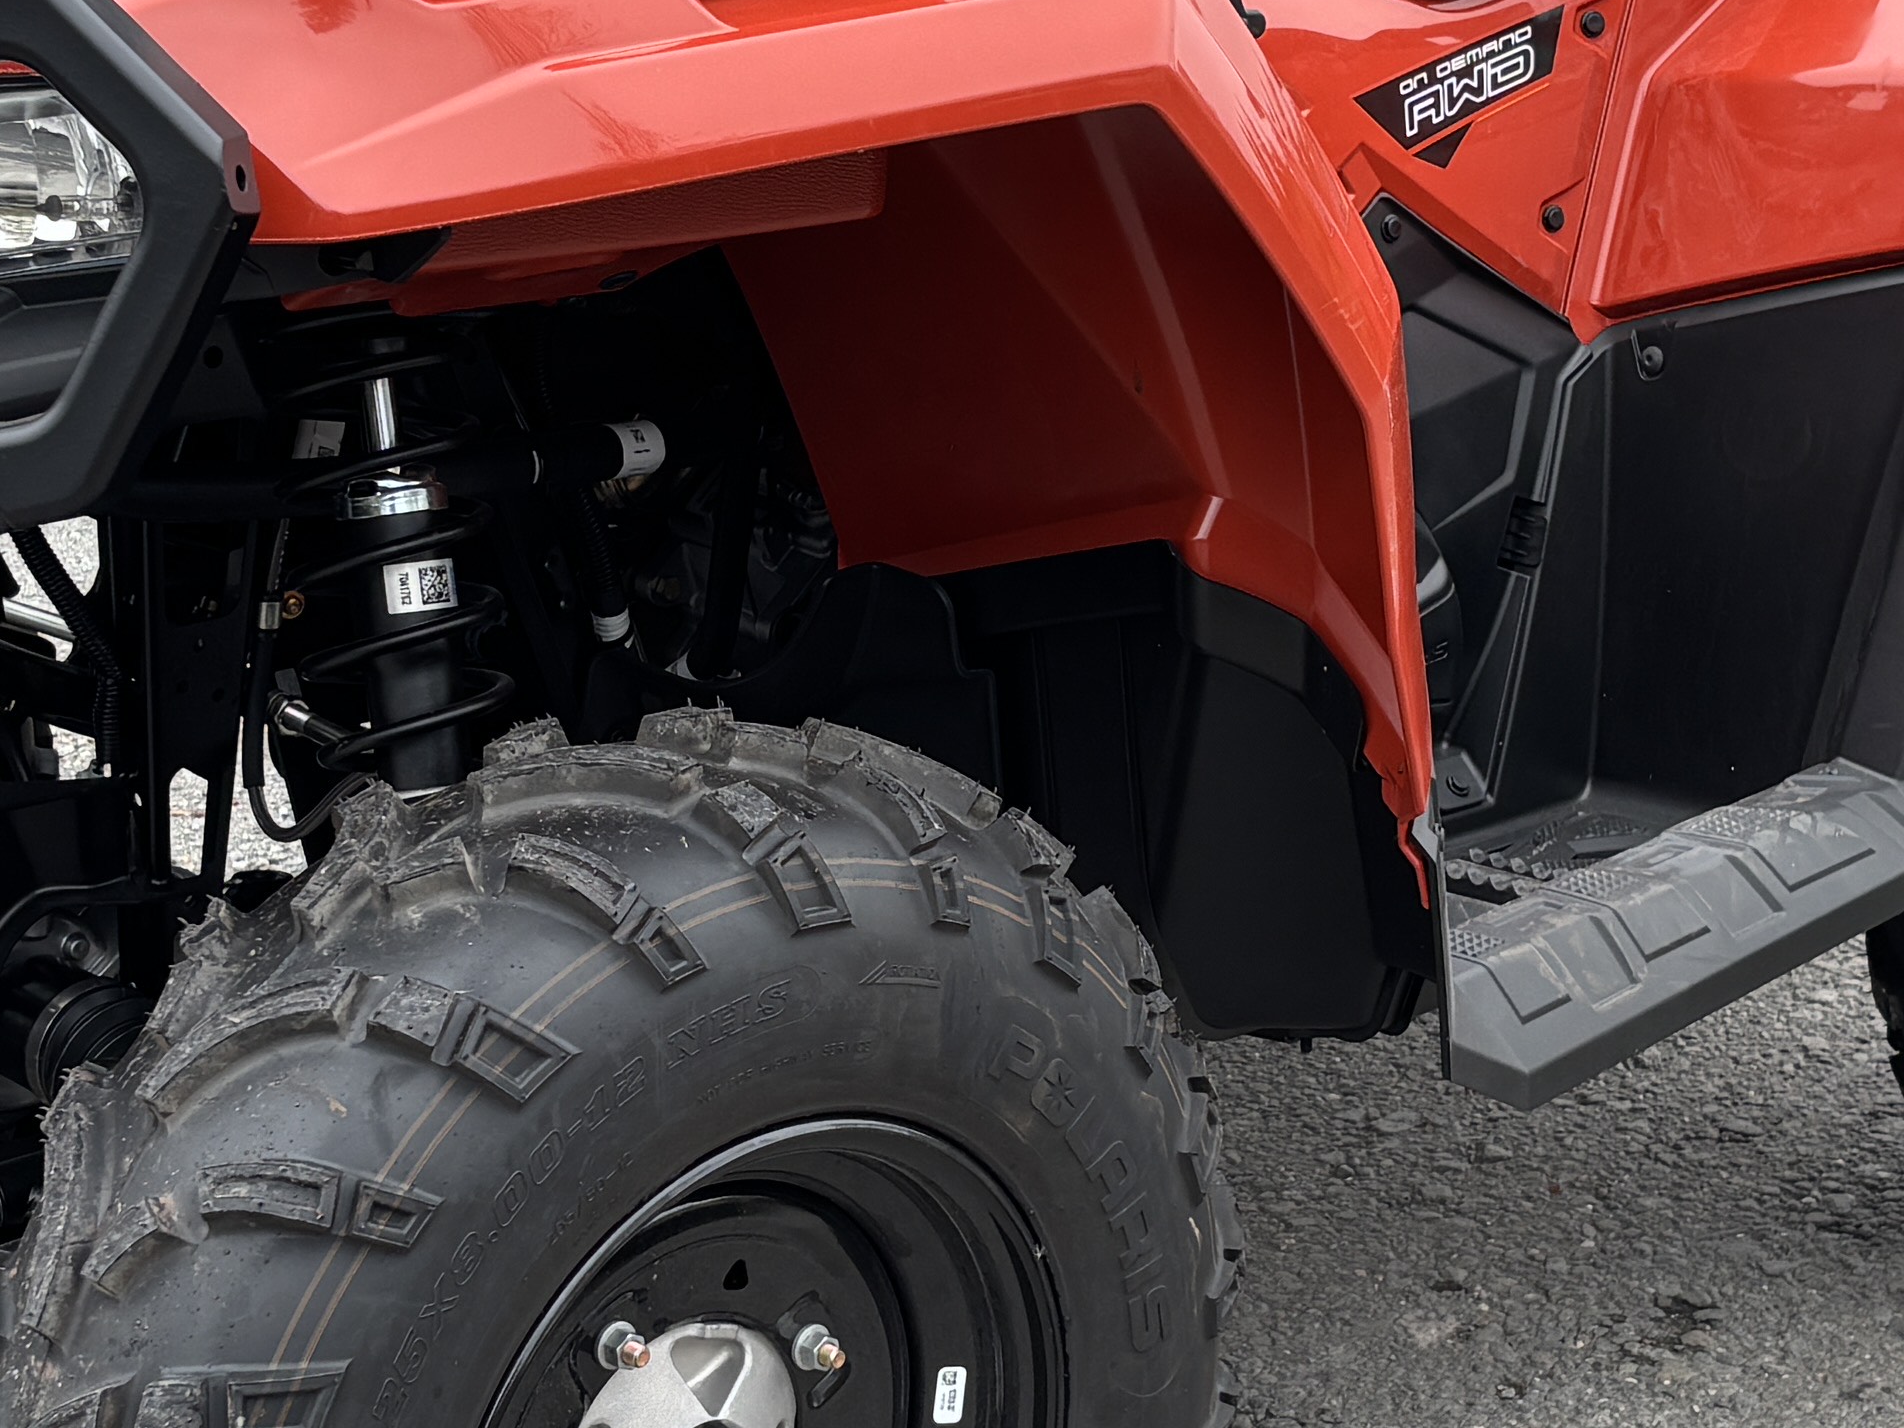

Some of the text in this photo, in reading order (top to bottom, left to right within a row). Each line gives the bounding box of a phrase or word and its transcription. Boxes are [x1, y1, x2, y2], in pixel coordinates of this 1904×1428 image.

[1399, 24, 1532, 96] ON DEMAND
[1404, 43, 1536, 138] AWD
[666, 978, 793, 1071] NHS
[989, 1024, 1171, 1353] POLARIS
